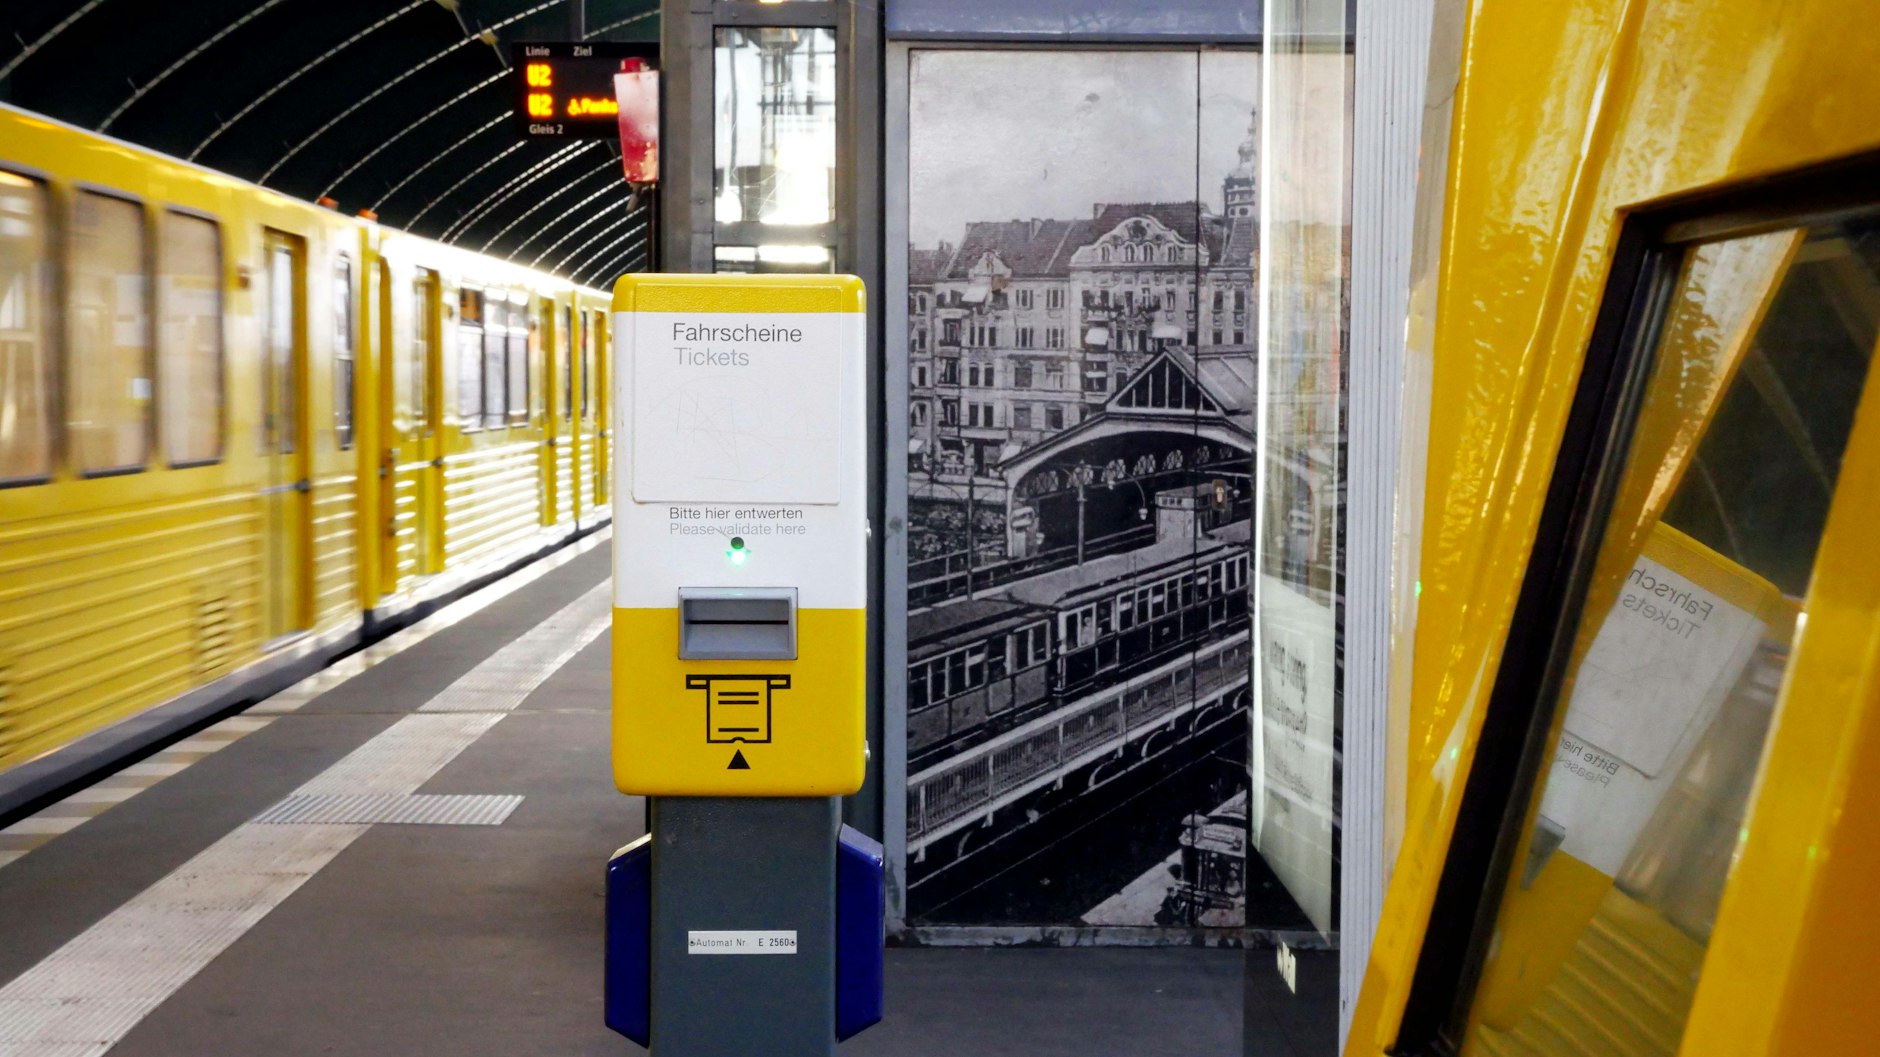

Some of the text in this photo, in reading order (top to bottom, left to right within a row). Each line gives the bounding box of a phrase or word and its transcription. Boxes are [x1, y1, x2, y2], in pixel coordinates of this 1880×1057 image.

[526, 46, 550, 56] Linie
[573, 46, 592, 56] Ziel
[527, 64, 552, 87] U2
[527, 93, 553, 116] U2
[529, 124, 563, 134] Gleis 2
[673, 322, 802, 342] Fahrscheine
[674, 347, 749, 366] Tickets
[670, 507, 802, 519] Bitte hier entwerten
[670, 523, 806, 535] Please validate here
[758, 938, 764, 946] E
[769, 938, 789, 946] 2560
